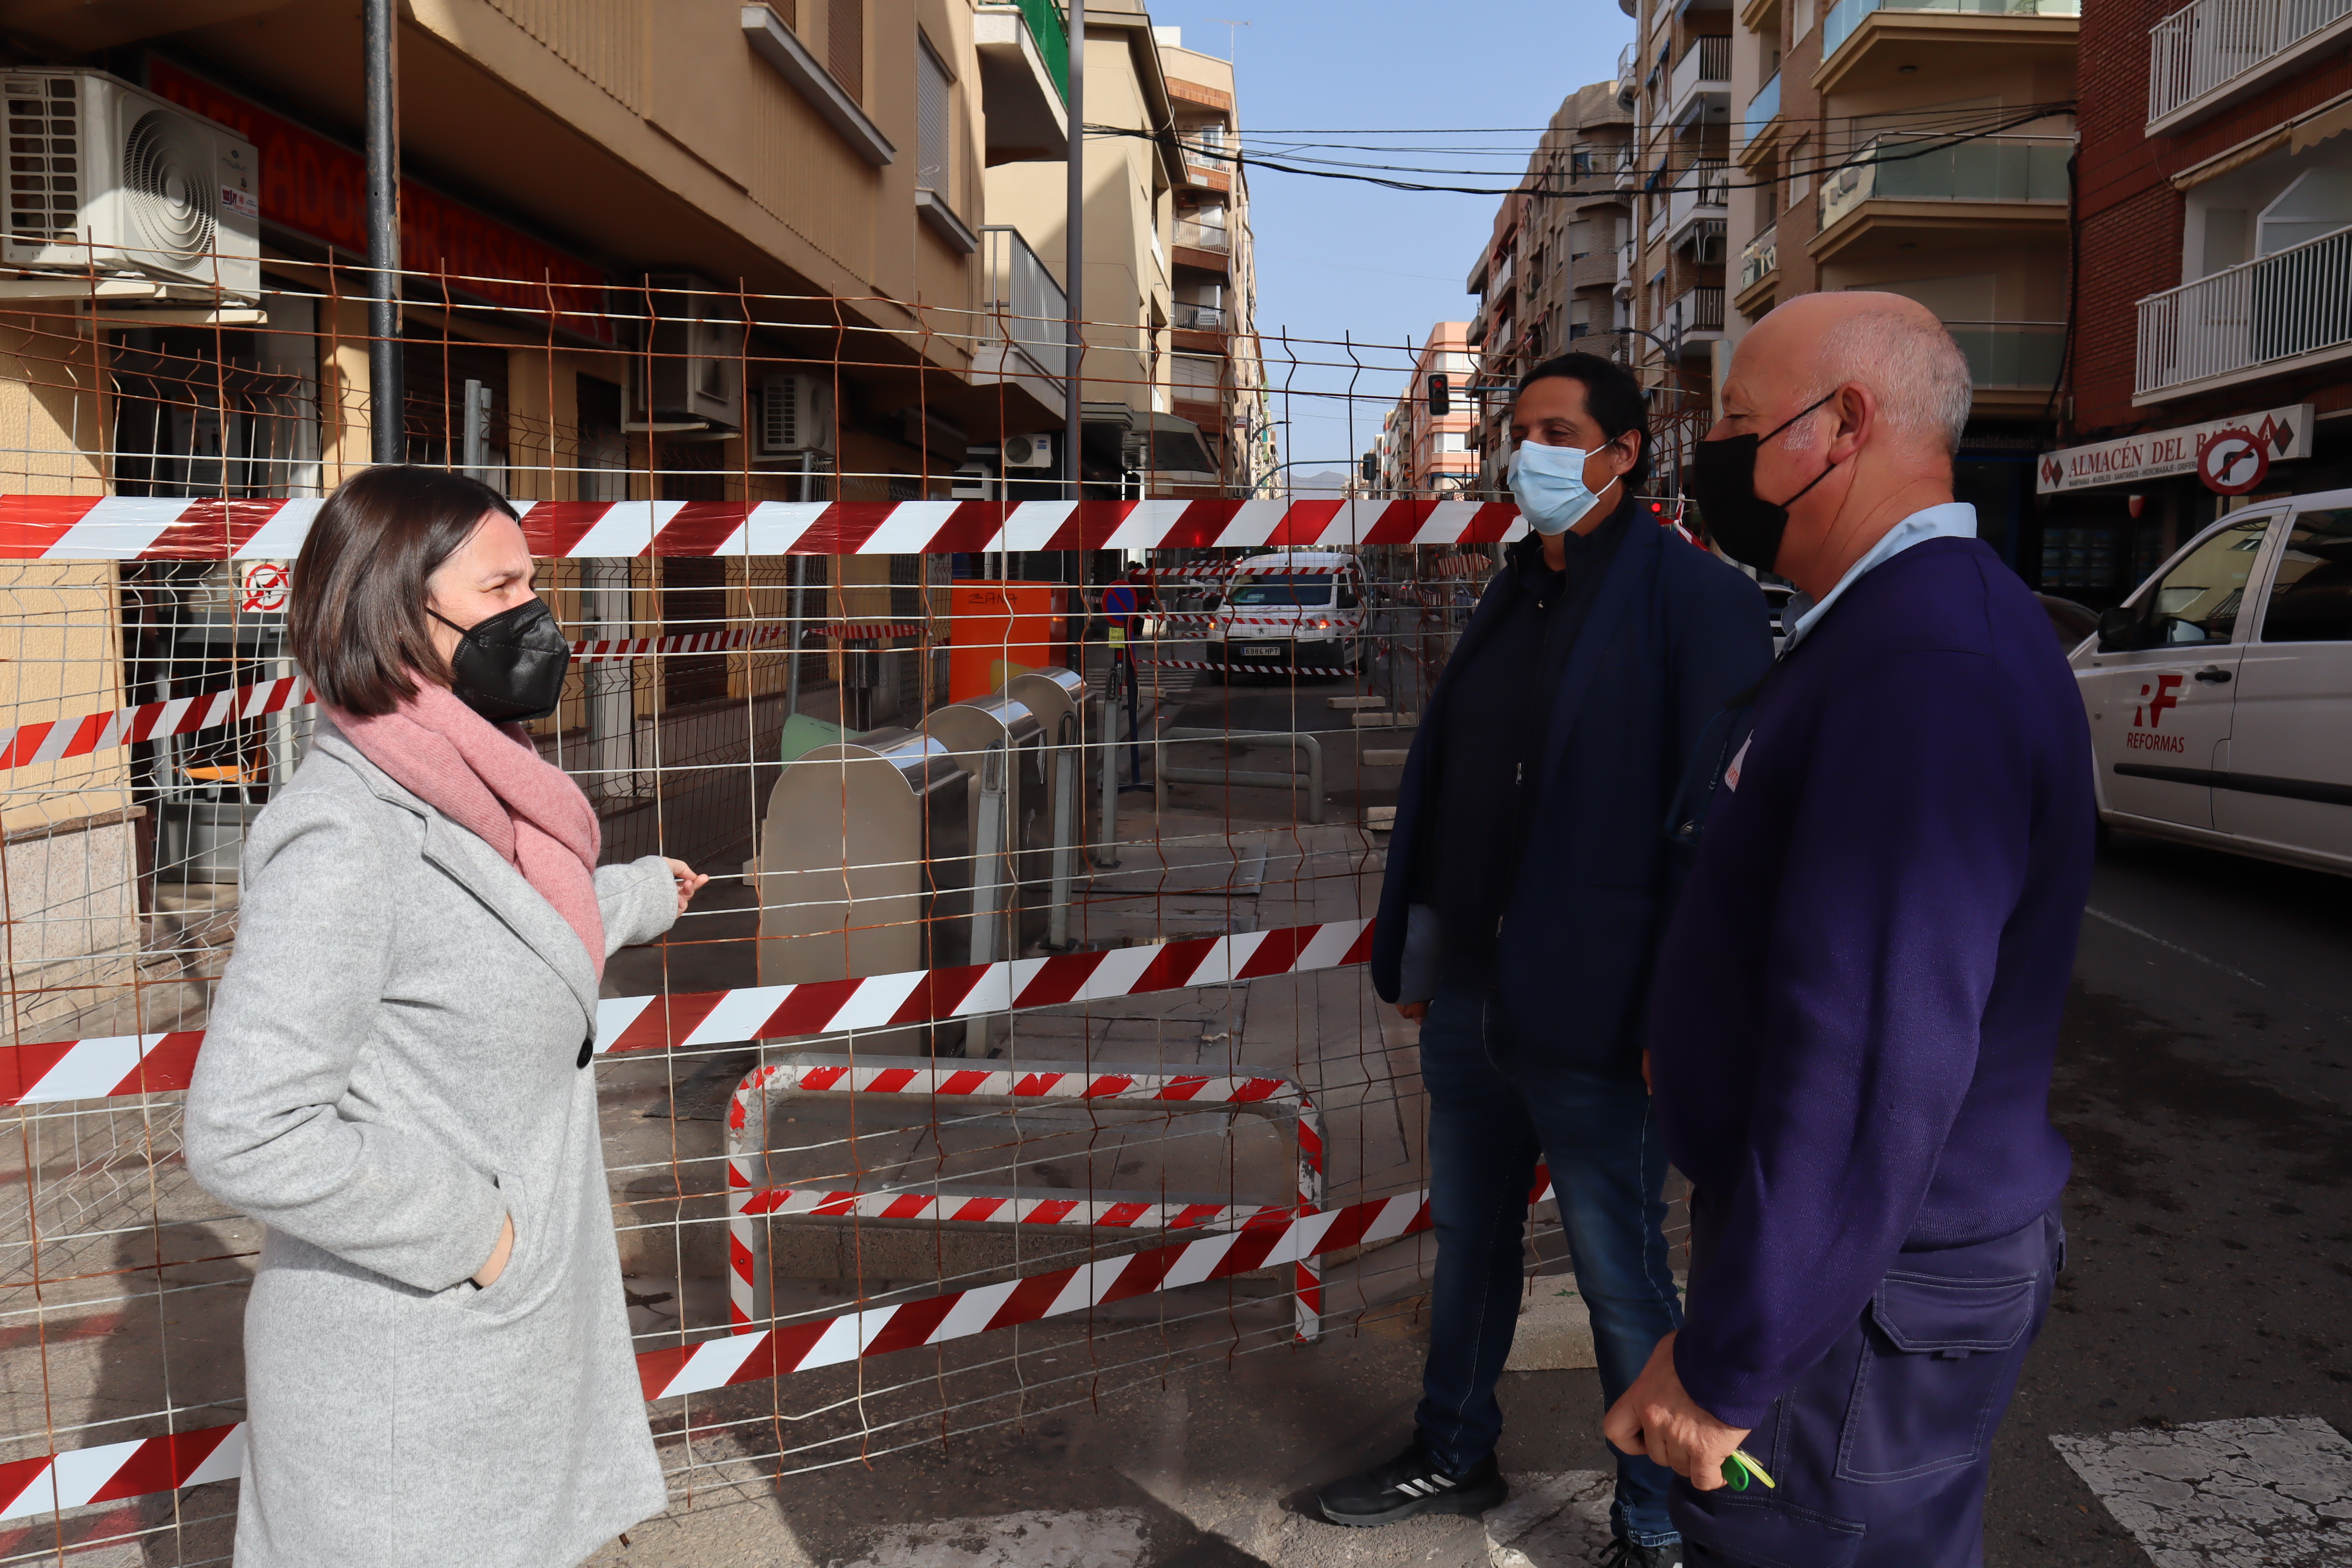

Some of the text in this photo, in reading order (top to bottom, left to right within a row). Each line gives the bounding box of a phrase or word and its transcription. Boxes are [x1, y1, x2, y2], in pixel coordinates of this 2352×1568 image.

[2068, 441, 2144, 478] ALMACÉN
[2152, 437, 2186, 464] DEL
[2069, 477, 2090, 486] MAMPARAS
[2093, 474, 2111, 484] MUEBLES
[2114, 470, 2139, 481] SANITARIOS
[2142, 464, 2174, 476] HIDROMASAJE
[1245, 647, 1263, 655] 6984
[2126, 732, 2185, 753] REFORMAS
